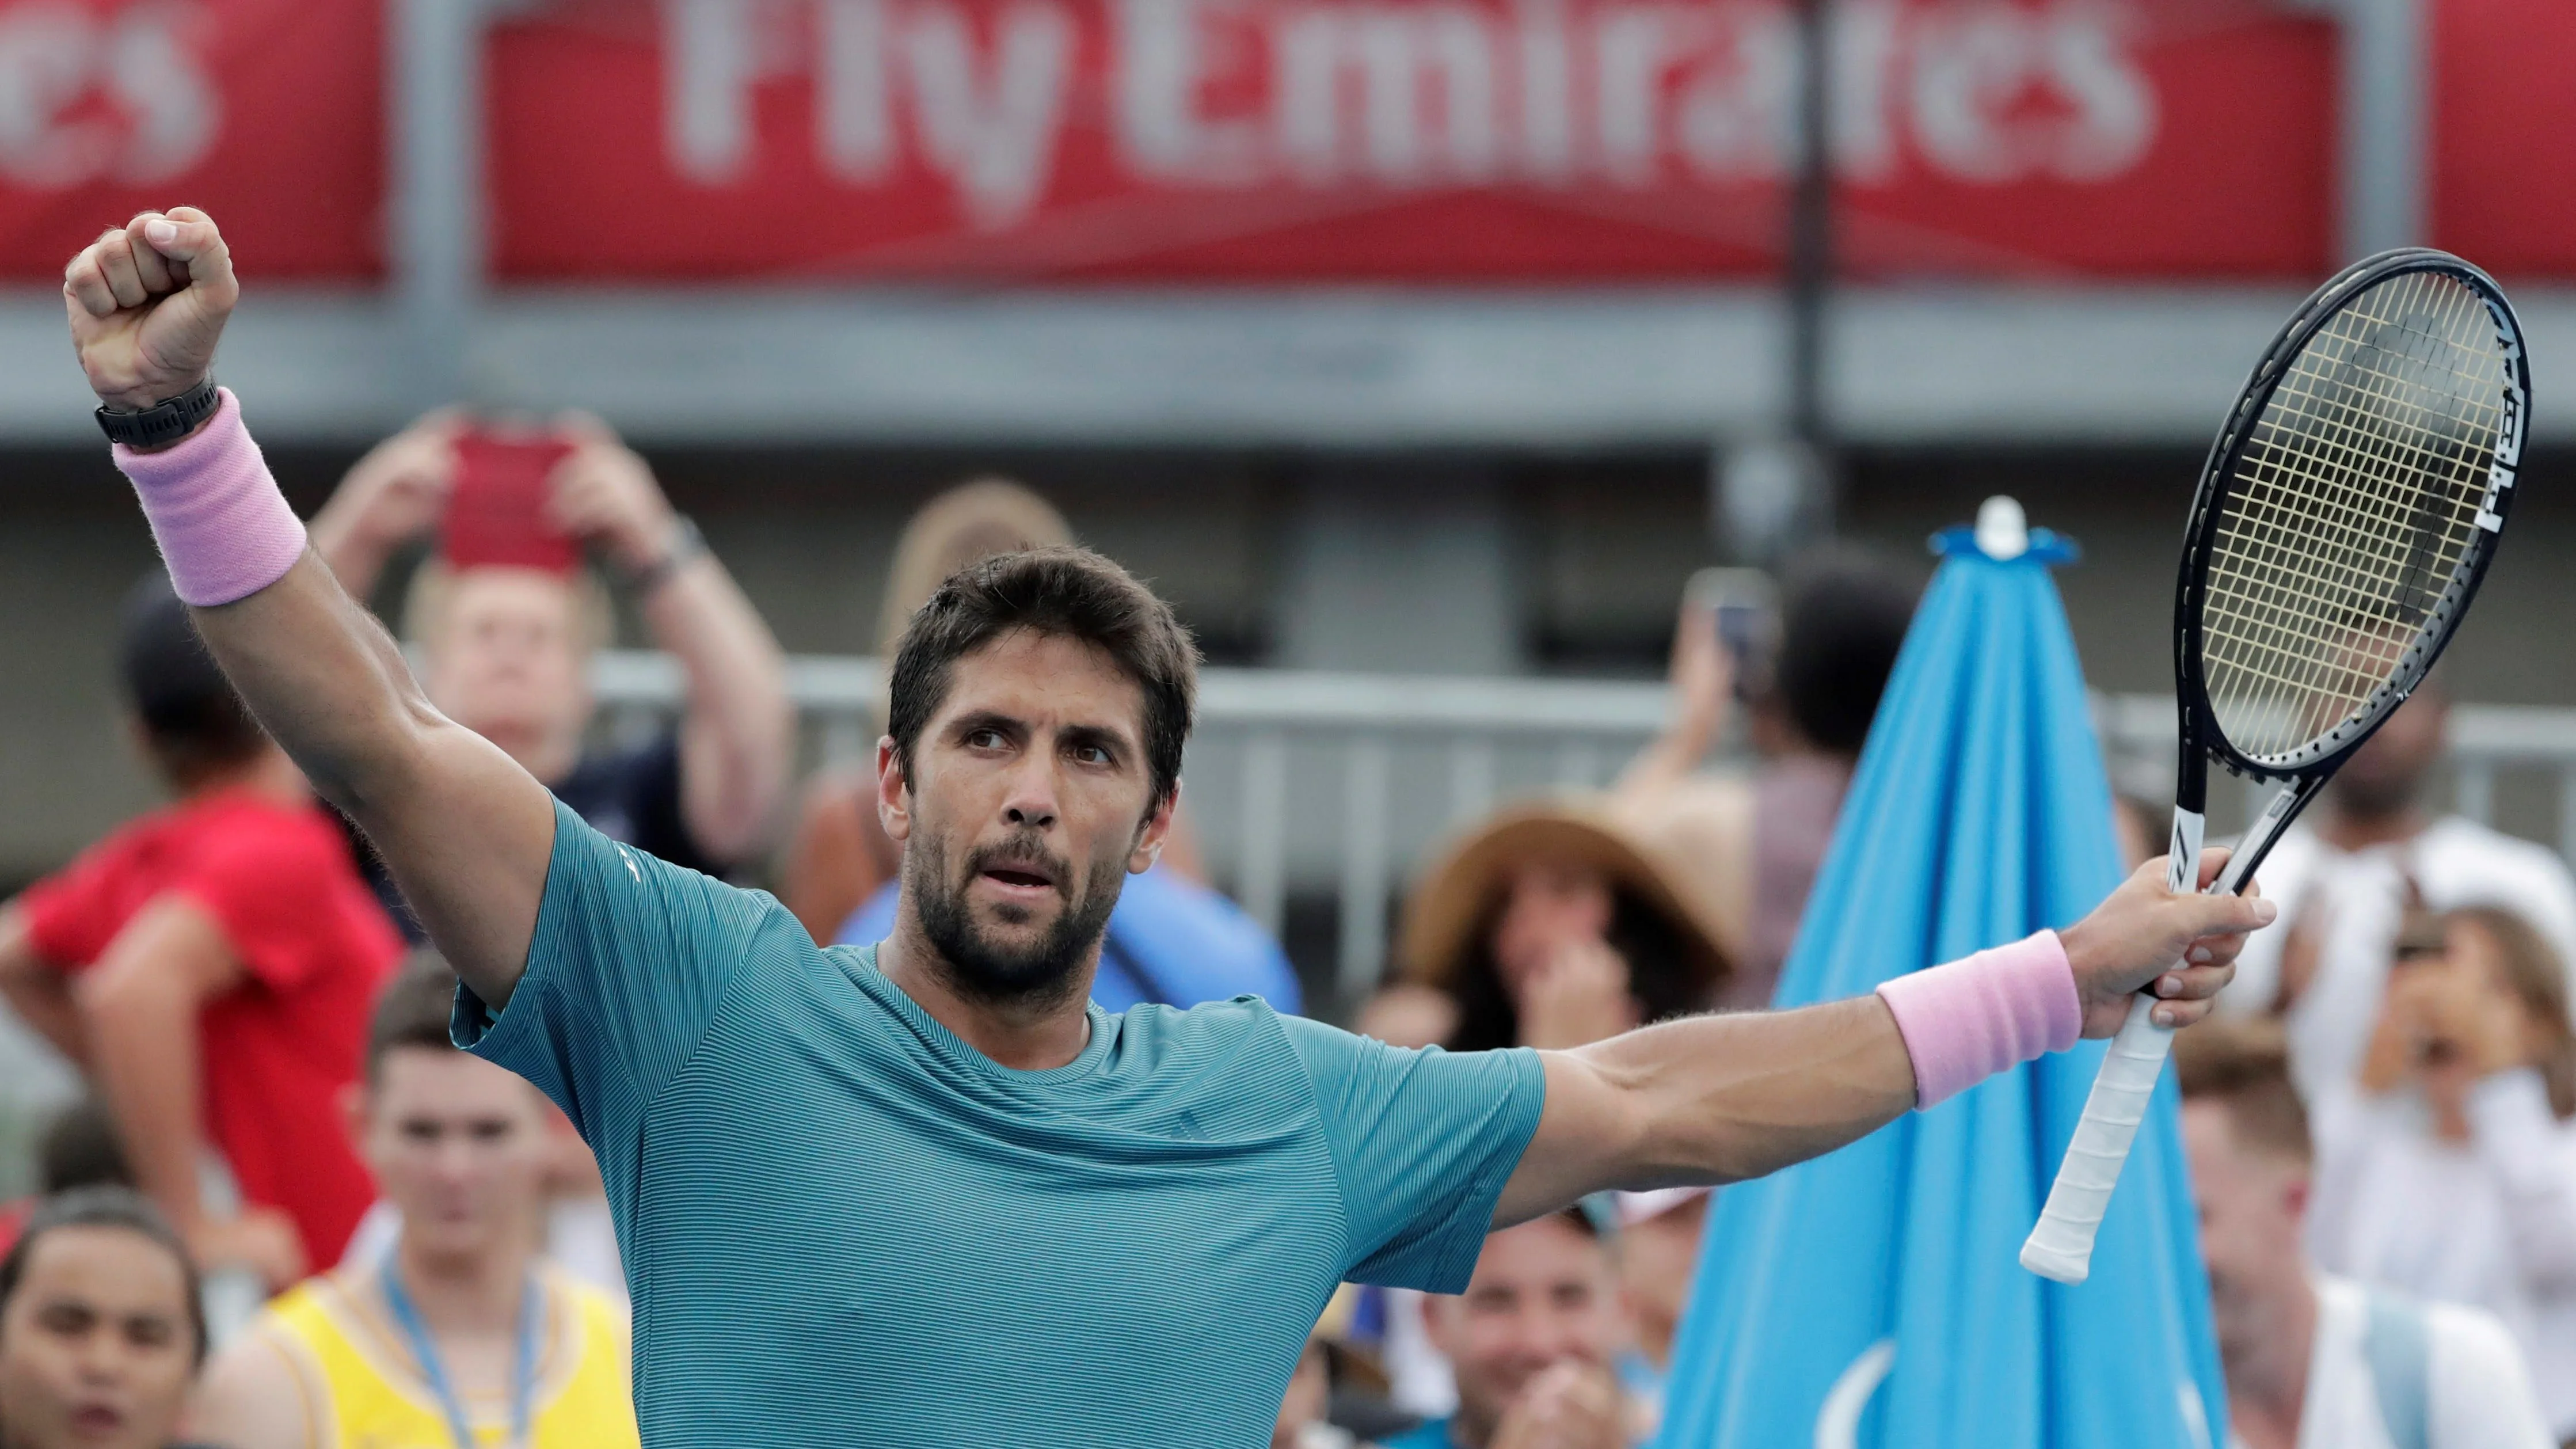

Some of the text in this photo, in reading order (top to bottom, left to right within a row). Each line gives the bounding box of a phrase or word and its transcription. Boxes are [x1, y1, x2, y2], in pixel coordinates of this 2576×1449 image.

[665, 0, 2159, 230] Fly Emirates
[2474, 295, 2526, 534] HEAD
